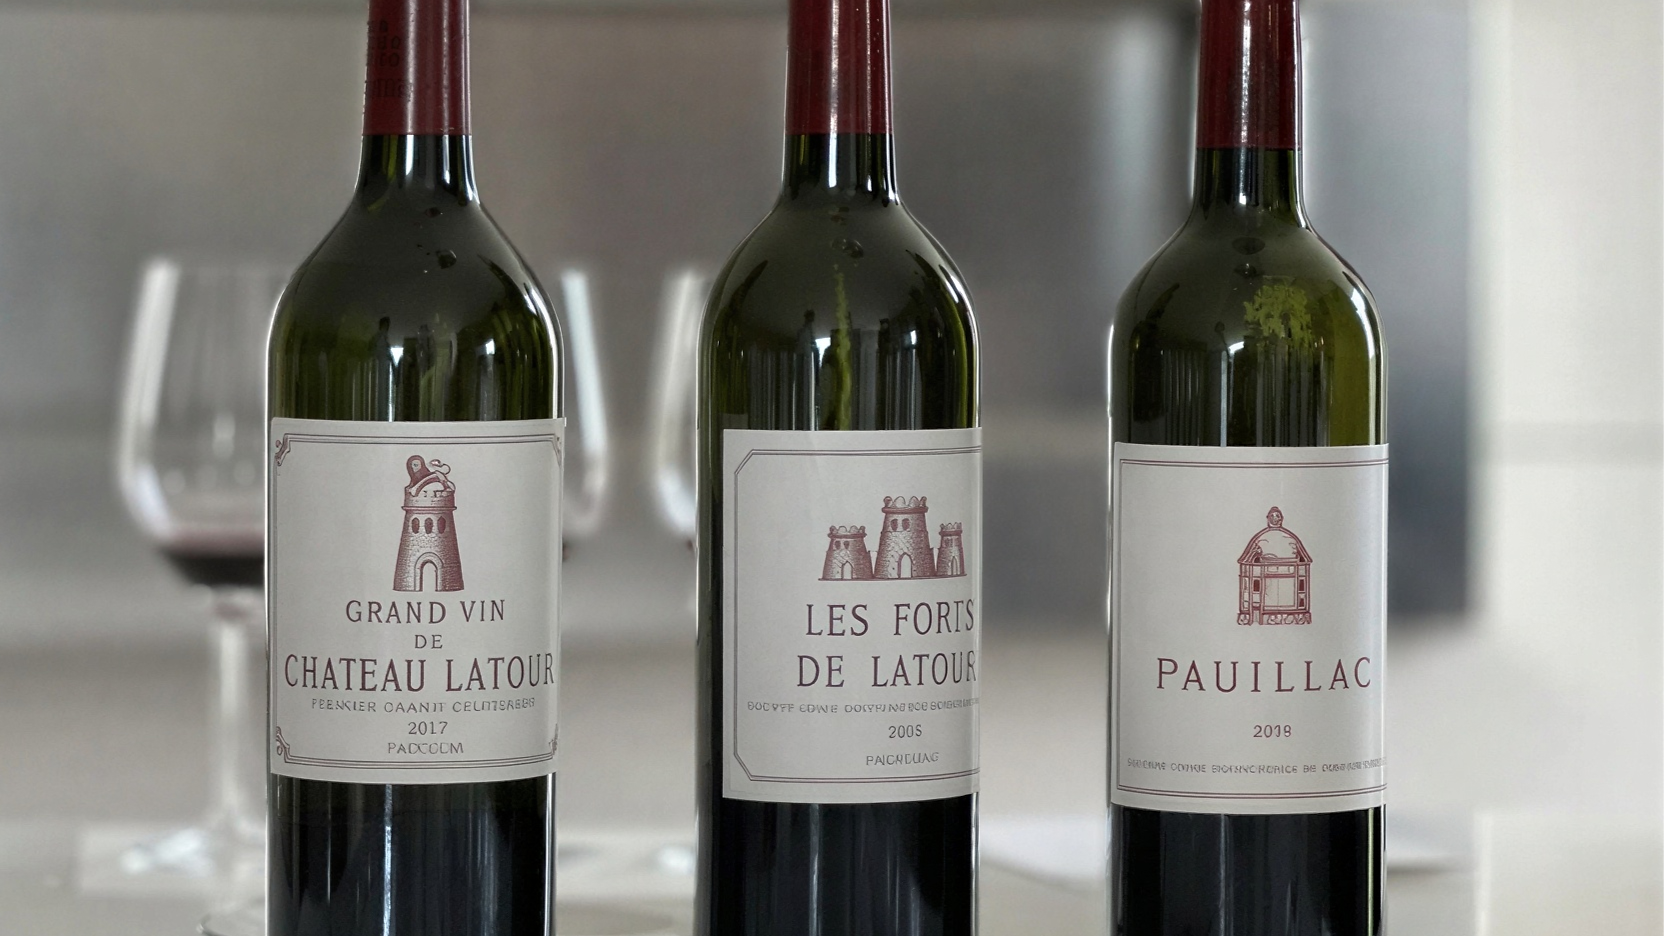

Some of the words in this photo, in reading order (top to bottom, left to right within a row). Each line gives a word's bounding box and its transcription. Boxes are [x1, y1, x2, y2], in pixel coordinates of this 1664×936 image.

[345, 599, 447, 625] GRAND
[459, 599, 506, 623] VIN
[805, 603, 869, 637] LES
[892, 598, 974, 636] FORTS
[414, 633, 444, 649] DE
[284, 653, 427, 693] CHATEAU
[445, 652, 556, 693] LATOUR
[796, 654, 845, 688] DE
[871, 650, 978, 688] LATOUR
[1156, 656, 1371, 694] PAUILLAC
[407, 720, 449, 736] 2017
